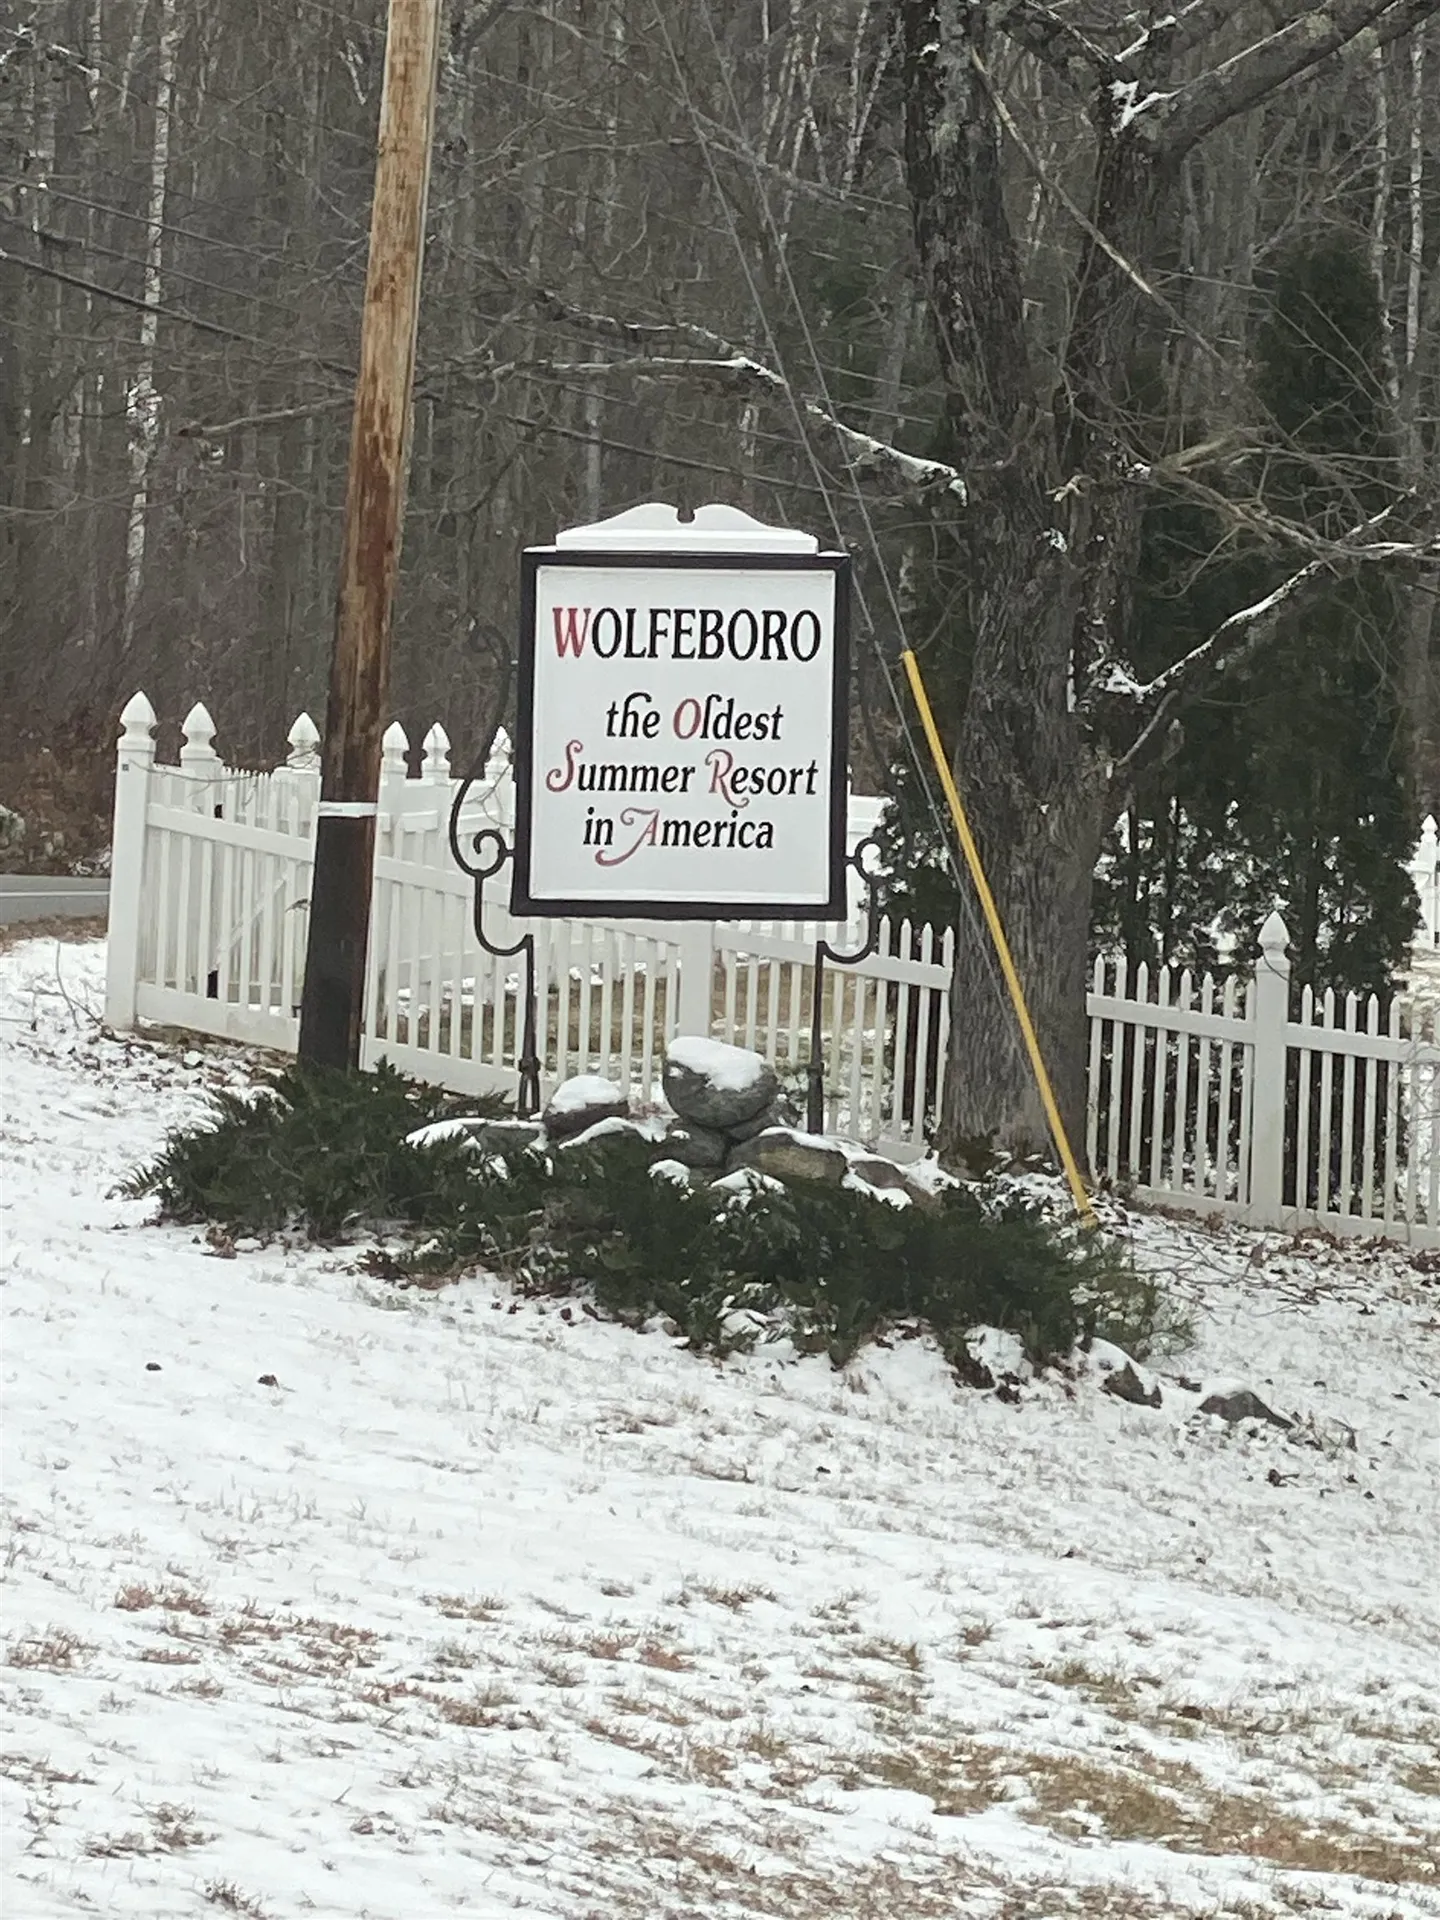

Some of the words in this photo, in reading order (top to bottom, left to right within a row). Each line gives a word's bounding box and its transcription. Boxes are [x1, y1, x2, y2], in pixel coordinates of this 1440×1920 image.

[553, 607, 822, 663] WOLFEBORO
[606, 692, 661, 738] the
[673, 694, 784, 740] Oldest
[546, 740, 696, 793] Summer
[705, 749, 818, 808] Resort
[583, 806, 614, 846] in
[595, 807, 774, 867] America
